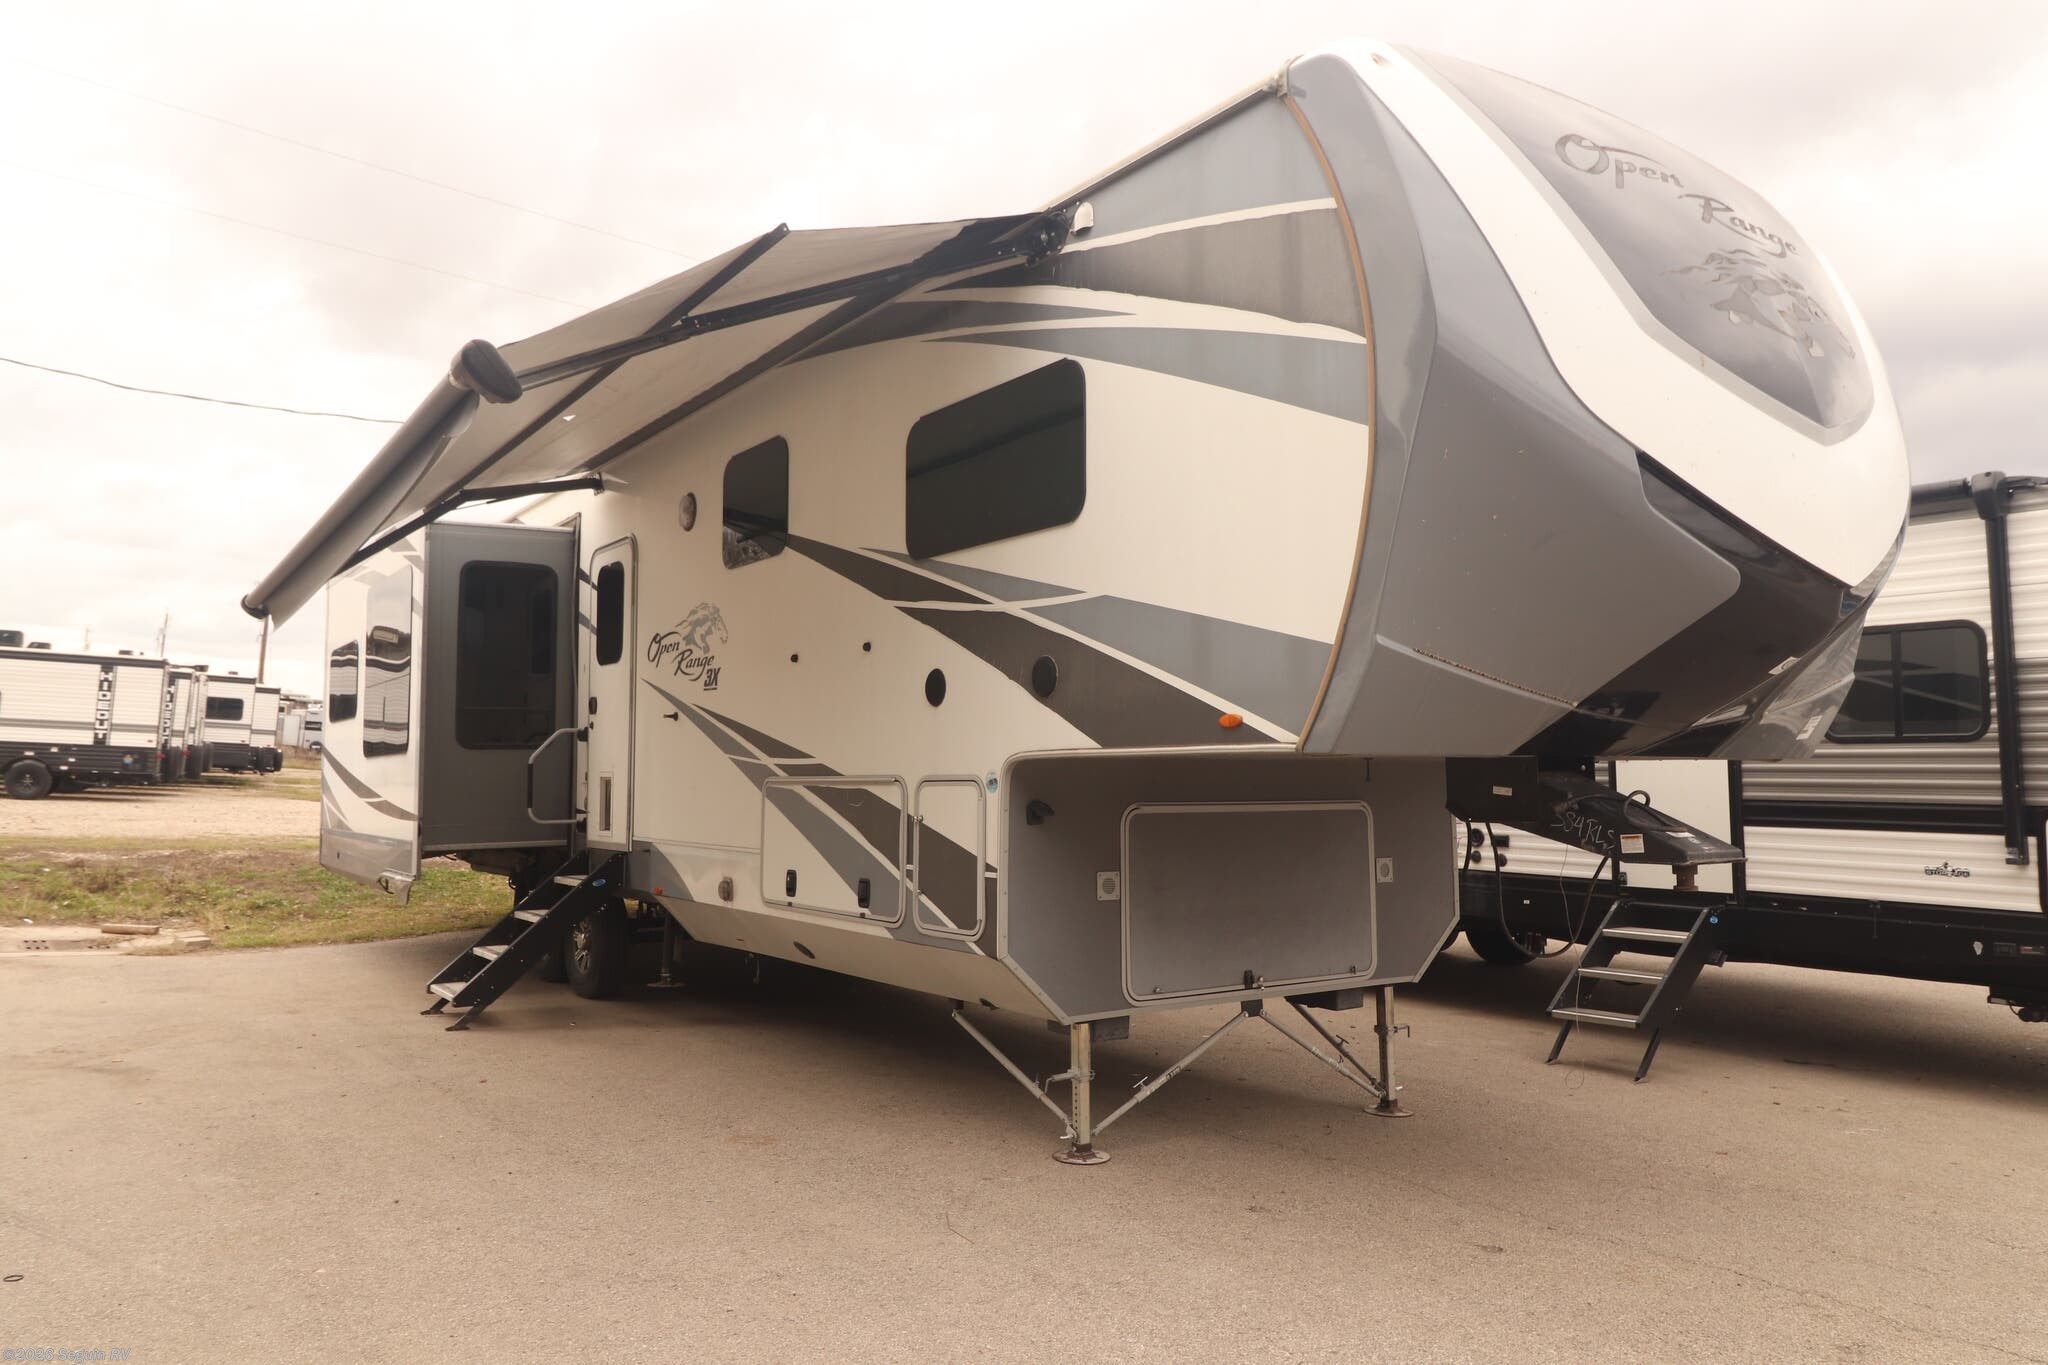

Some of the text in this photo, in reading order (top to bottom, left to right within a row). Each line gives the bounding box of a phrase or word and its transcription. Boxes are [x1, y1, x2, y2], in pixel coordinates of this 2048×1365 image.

[1555, 134, 1684, 189] Open
[1677, 193, 1799, 259] Range
[647, 631, 681, 668] Open
[671, 648, 715, 681] Range
[704, 667, 721, 687] 3X
[94, 671, 113, 739] HIDEOUT
